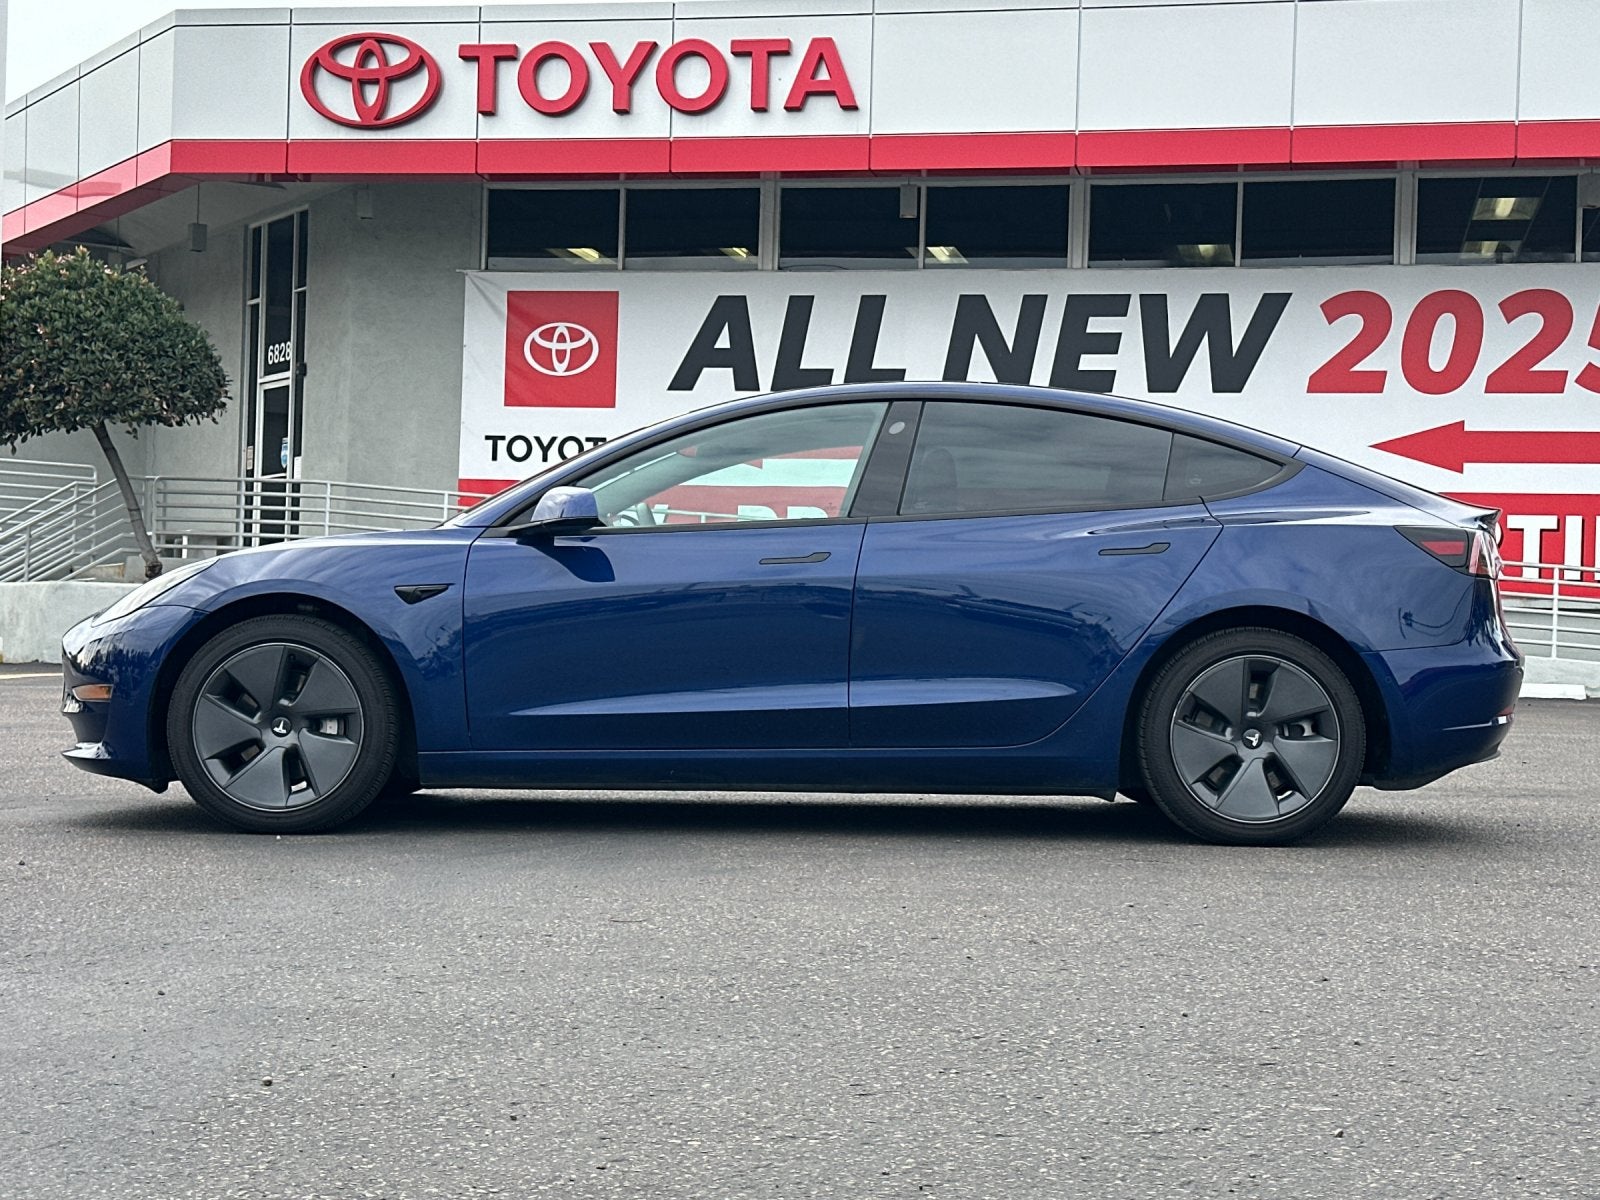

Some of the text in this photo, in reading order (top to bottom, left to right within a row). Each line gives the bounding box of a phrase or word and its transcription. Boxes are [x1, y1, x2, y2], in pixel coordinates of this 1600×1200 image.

[458, 37, 859, 116] TOYOTA
[268, 342, 291, 365] 6828
[666, 294, 906, 392] ALL
[942, 292, 1293, 393] NEW
